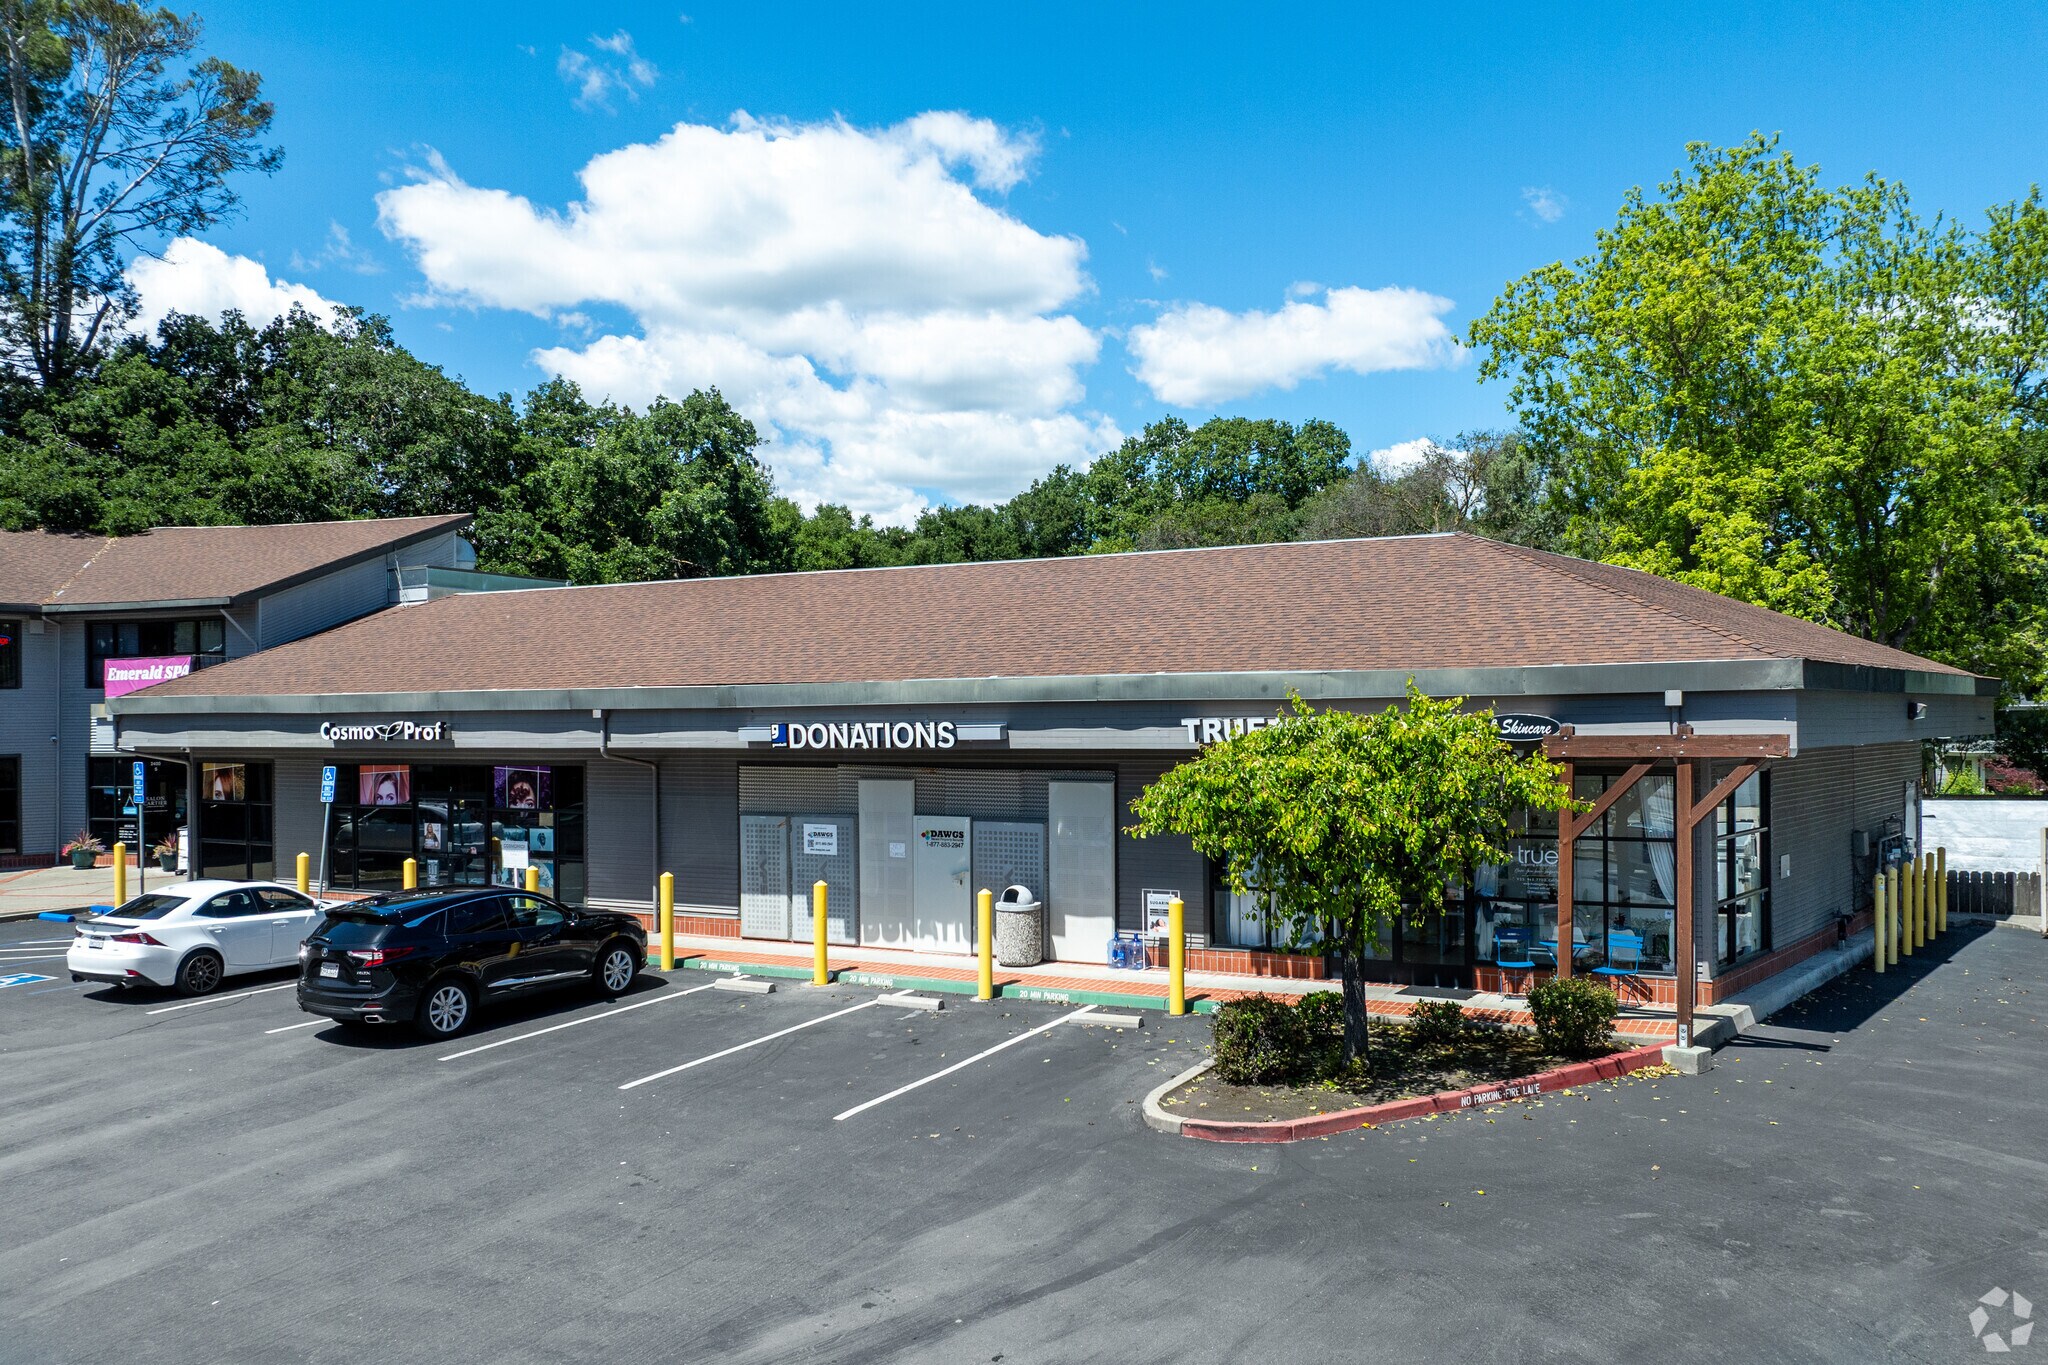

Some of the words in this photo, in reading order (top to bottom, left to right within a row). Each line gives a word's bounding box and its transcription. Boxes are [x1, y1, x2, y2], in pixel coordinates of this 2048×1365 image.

[106, 664, 163, 681] Emerald
[163, 664, 190, 680] SPA
[320, 721, 374, 741] Cosmo
[403, 721, 442, 741] Prof
[1501, 718, 1552, 735] Skincare
[788, 721, 956, 749] DONATIONS
[930, 829, 965, 839] DAWGS
[1517, 845, 1559, 865] true
[699, 961, 708, 970] 20
[708, 962, 718, 971] MIN
[719, 962, 740, 972] PARKING
[849, 974, 857, 983] 20
[870, 976, 894, 987] PARKING
[1019, 990, 1028, 998] 20
[1030, 990, 1042, 999] MIN
[1043, 991, 1069, 1001] PARKING
[1461, 1096, 1472, 1107] NO
